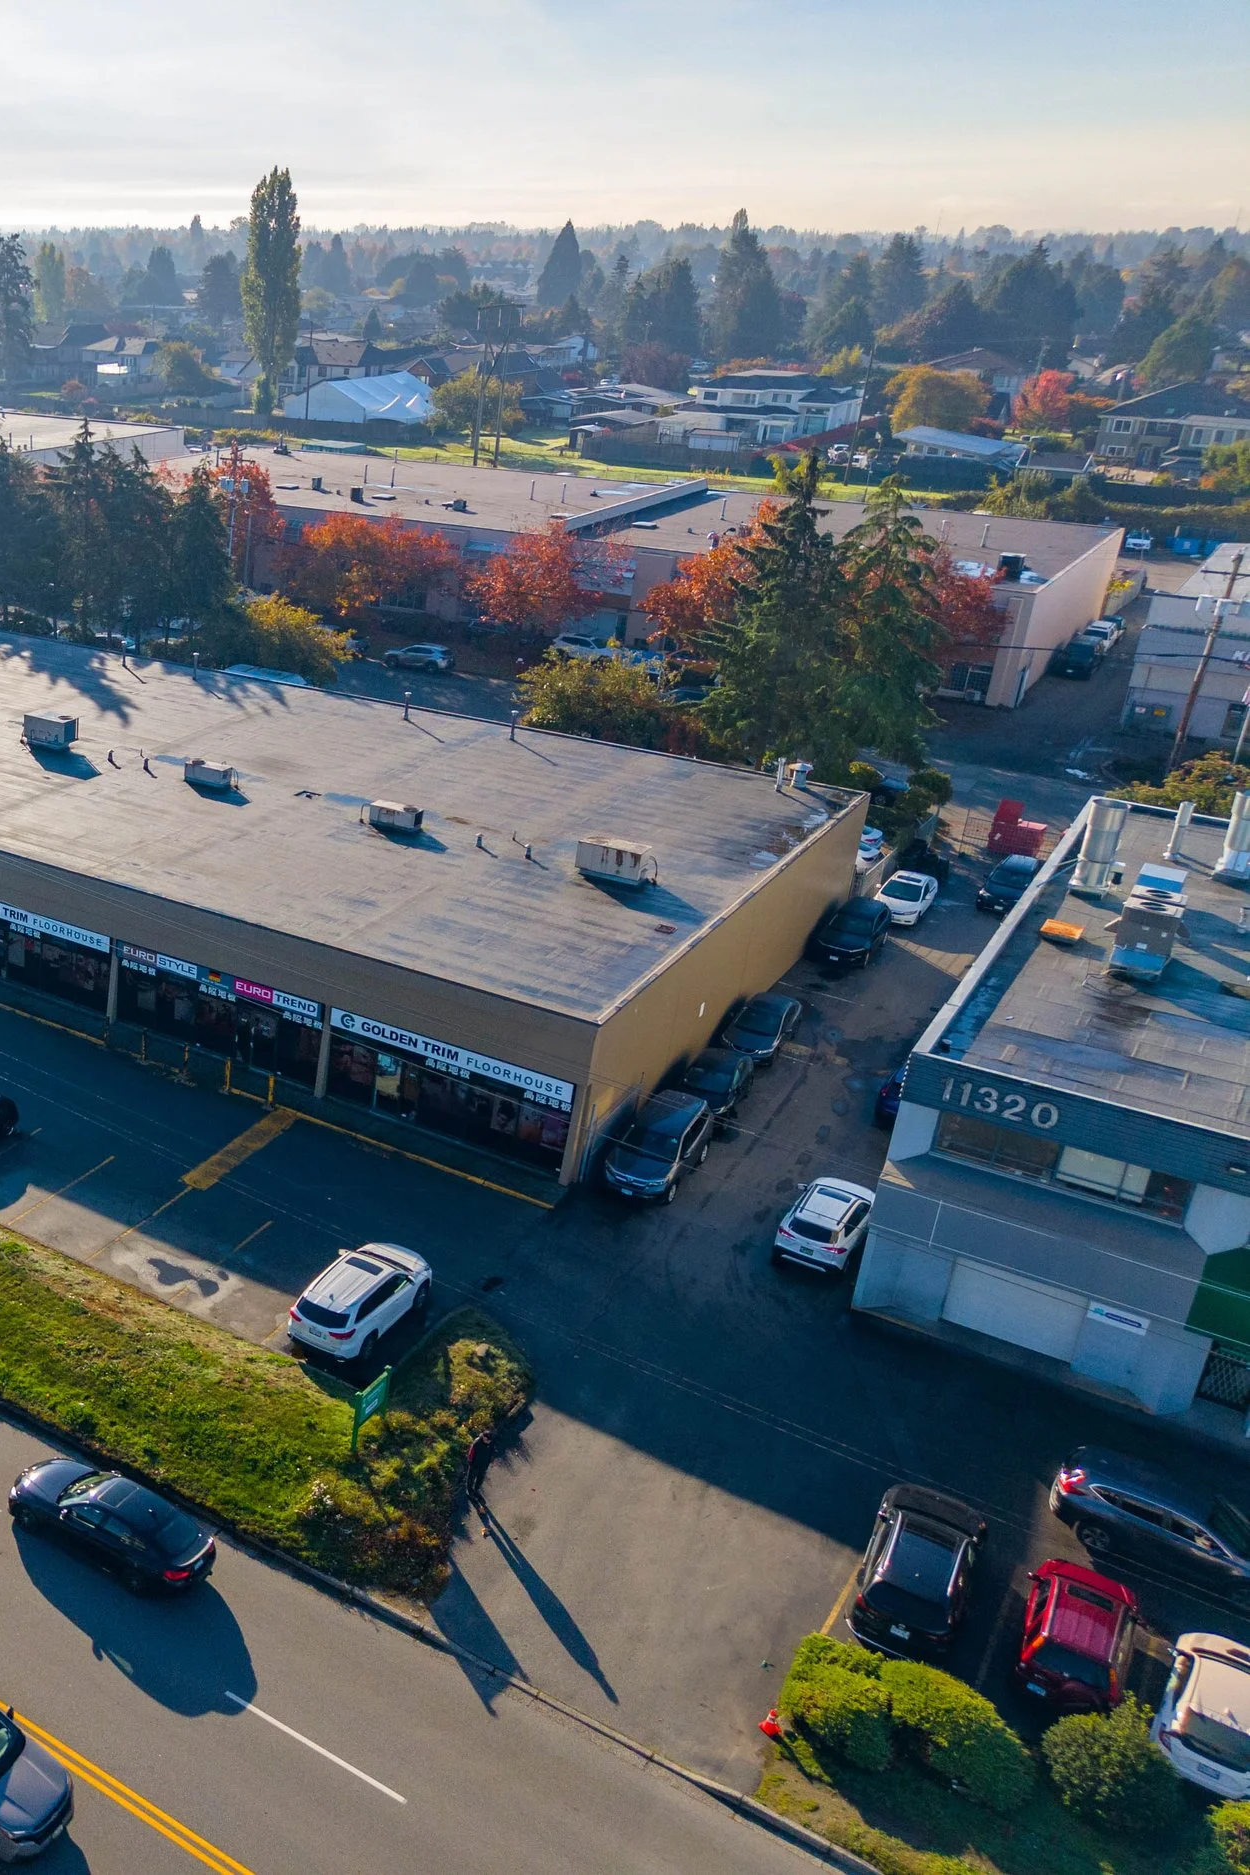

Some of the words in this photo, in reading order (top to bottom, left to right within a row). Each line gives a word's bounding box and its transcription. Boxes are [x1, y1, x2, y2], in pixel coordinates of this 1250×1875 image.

[2, 907, 28, 923] TRIM
[33, 918, 102, 947] FLOORHOUSE
[123, 946, 155, 963] EURO
[158, 957, 196, 975] STYLE
[235, 981, 271, 999] EURO
[275, 993, 316, 1013] TREND
[361, 1021, 419, 1049] GOLDEN
[422, 1040, 459, 1062] TRIM
[466, 1057, 563, 1096] FLOORHOUSE
[941, 1077, 1059, 1129] 11320
